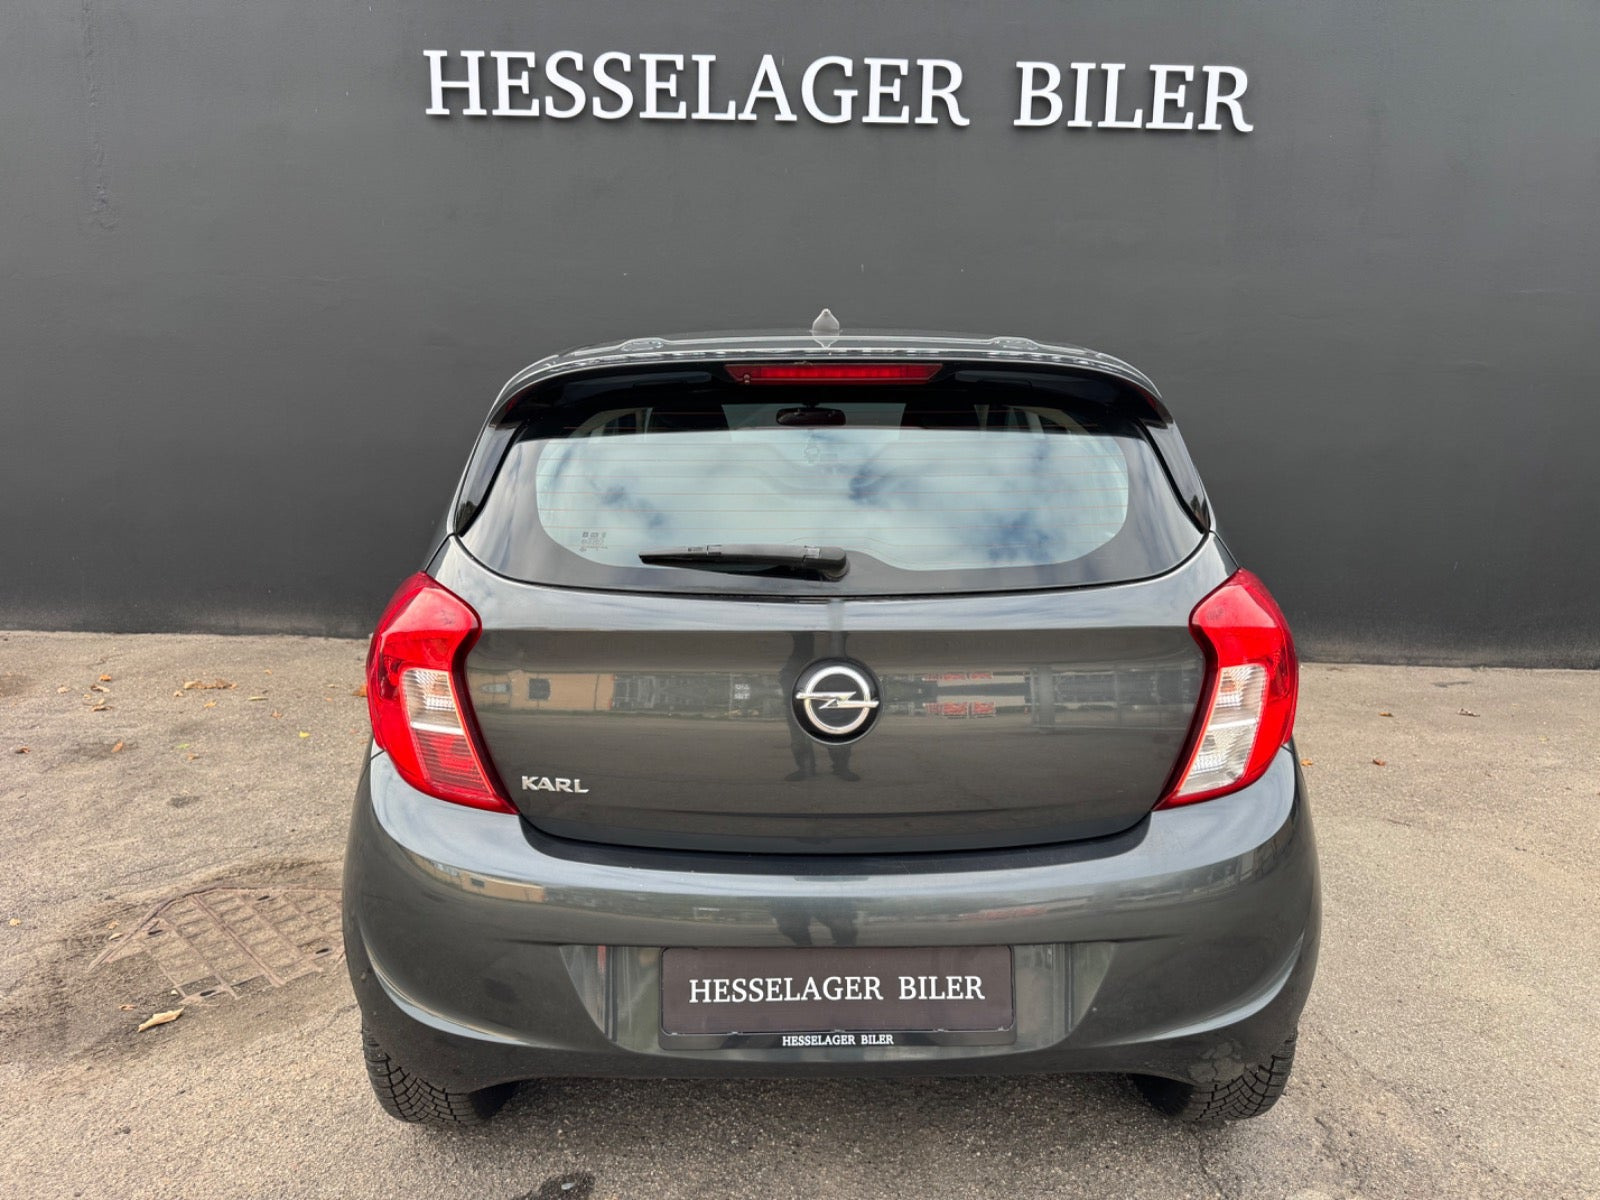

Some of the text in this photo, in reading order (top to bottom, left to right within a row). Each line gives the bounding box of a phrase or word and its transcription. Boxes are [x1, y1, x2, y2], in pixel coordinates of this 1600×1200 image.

[423, 49, 1254, 133] HESSELAGER BILER
[521, 775, 590, 794] KARL
[688, 975, 985, 1003] HESSELAGER BILER
[782, 1033, 895, 1047] HESSELAGER BILER
